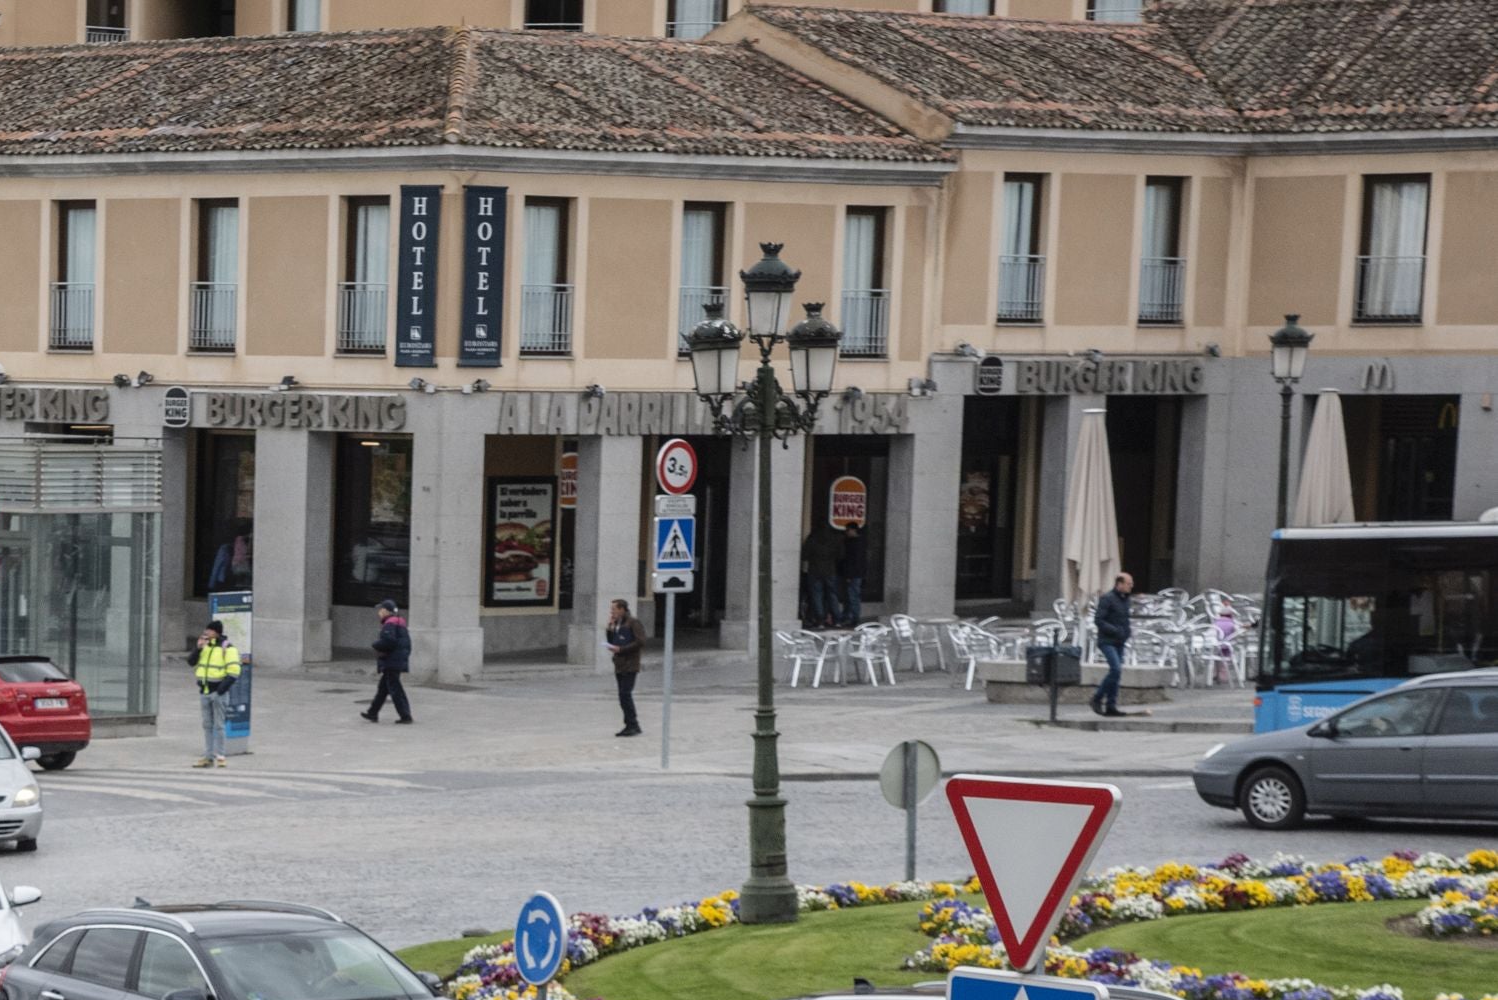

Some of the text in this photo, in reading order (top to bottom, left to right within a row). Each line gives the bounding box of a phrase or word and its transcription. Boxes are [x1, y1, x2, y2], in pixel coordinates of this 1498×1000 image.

[412, 197, 428, 315] HOTEL
[477, 197, 494, 315] HOTEL
[980, 376, 1002, 386] KING
[1016, 360, 1202, 394] BURGER KING
[38, 388, 108, 422] KING
[165, 408, 187, 418] KING
[206, 393, 406, 430] BURGER KING
[499, 395, 521, 434] A
[530, 395, 569, 434] LA
[833, 494, 863, 503] BURGER
[833, 504, 863, 518] KING
